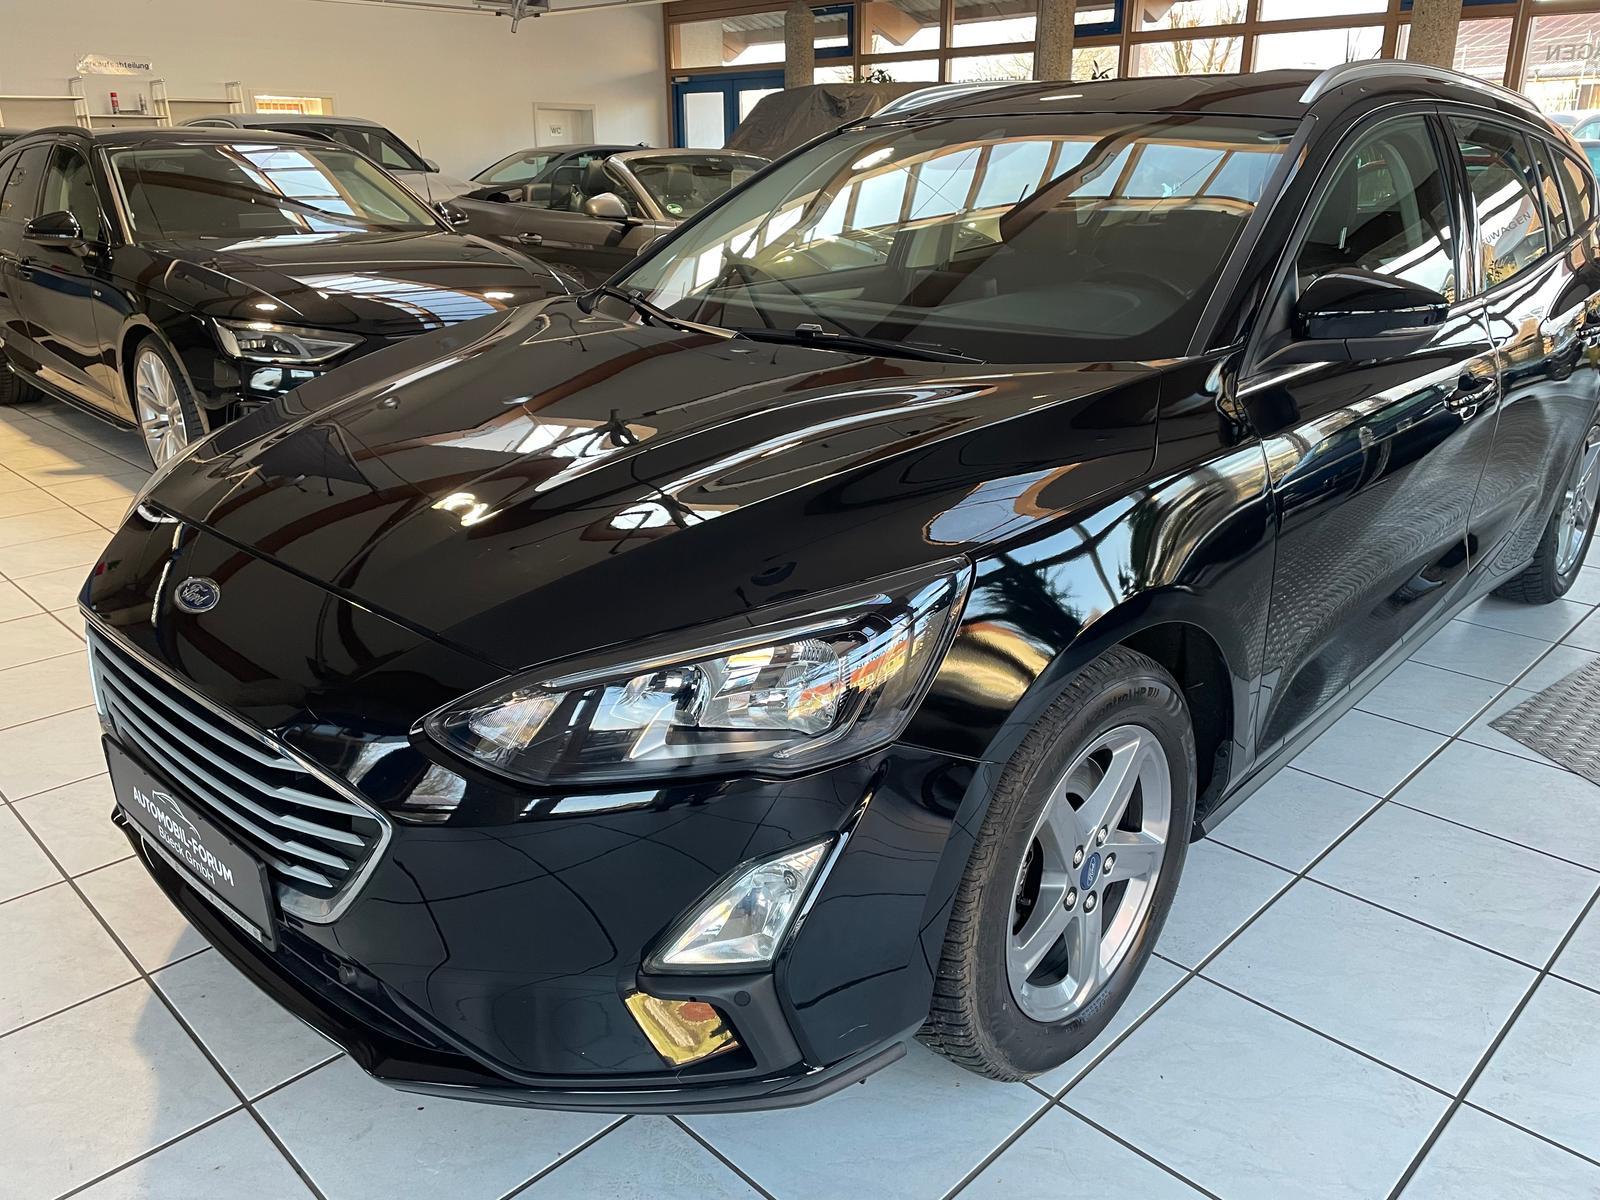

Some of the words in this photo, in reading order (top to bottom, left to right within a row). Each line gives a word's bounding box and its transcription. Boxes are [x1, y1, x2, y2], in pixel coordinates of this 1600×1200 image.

[550, 127, 561, 135] WC
[133, 786, 234, 887] AUTOMOBIL-FORUM
[185, 850, 216, 886] GmbH
